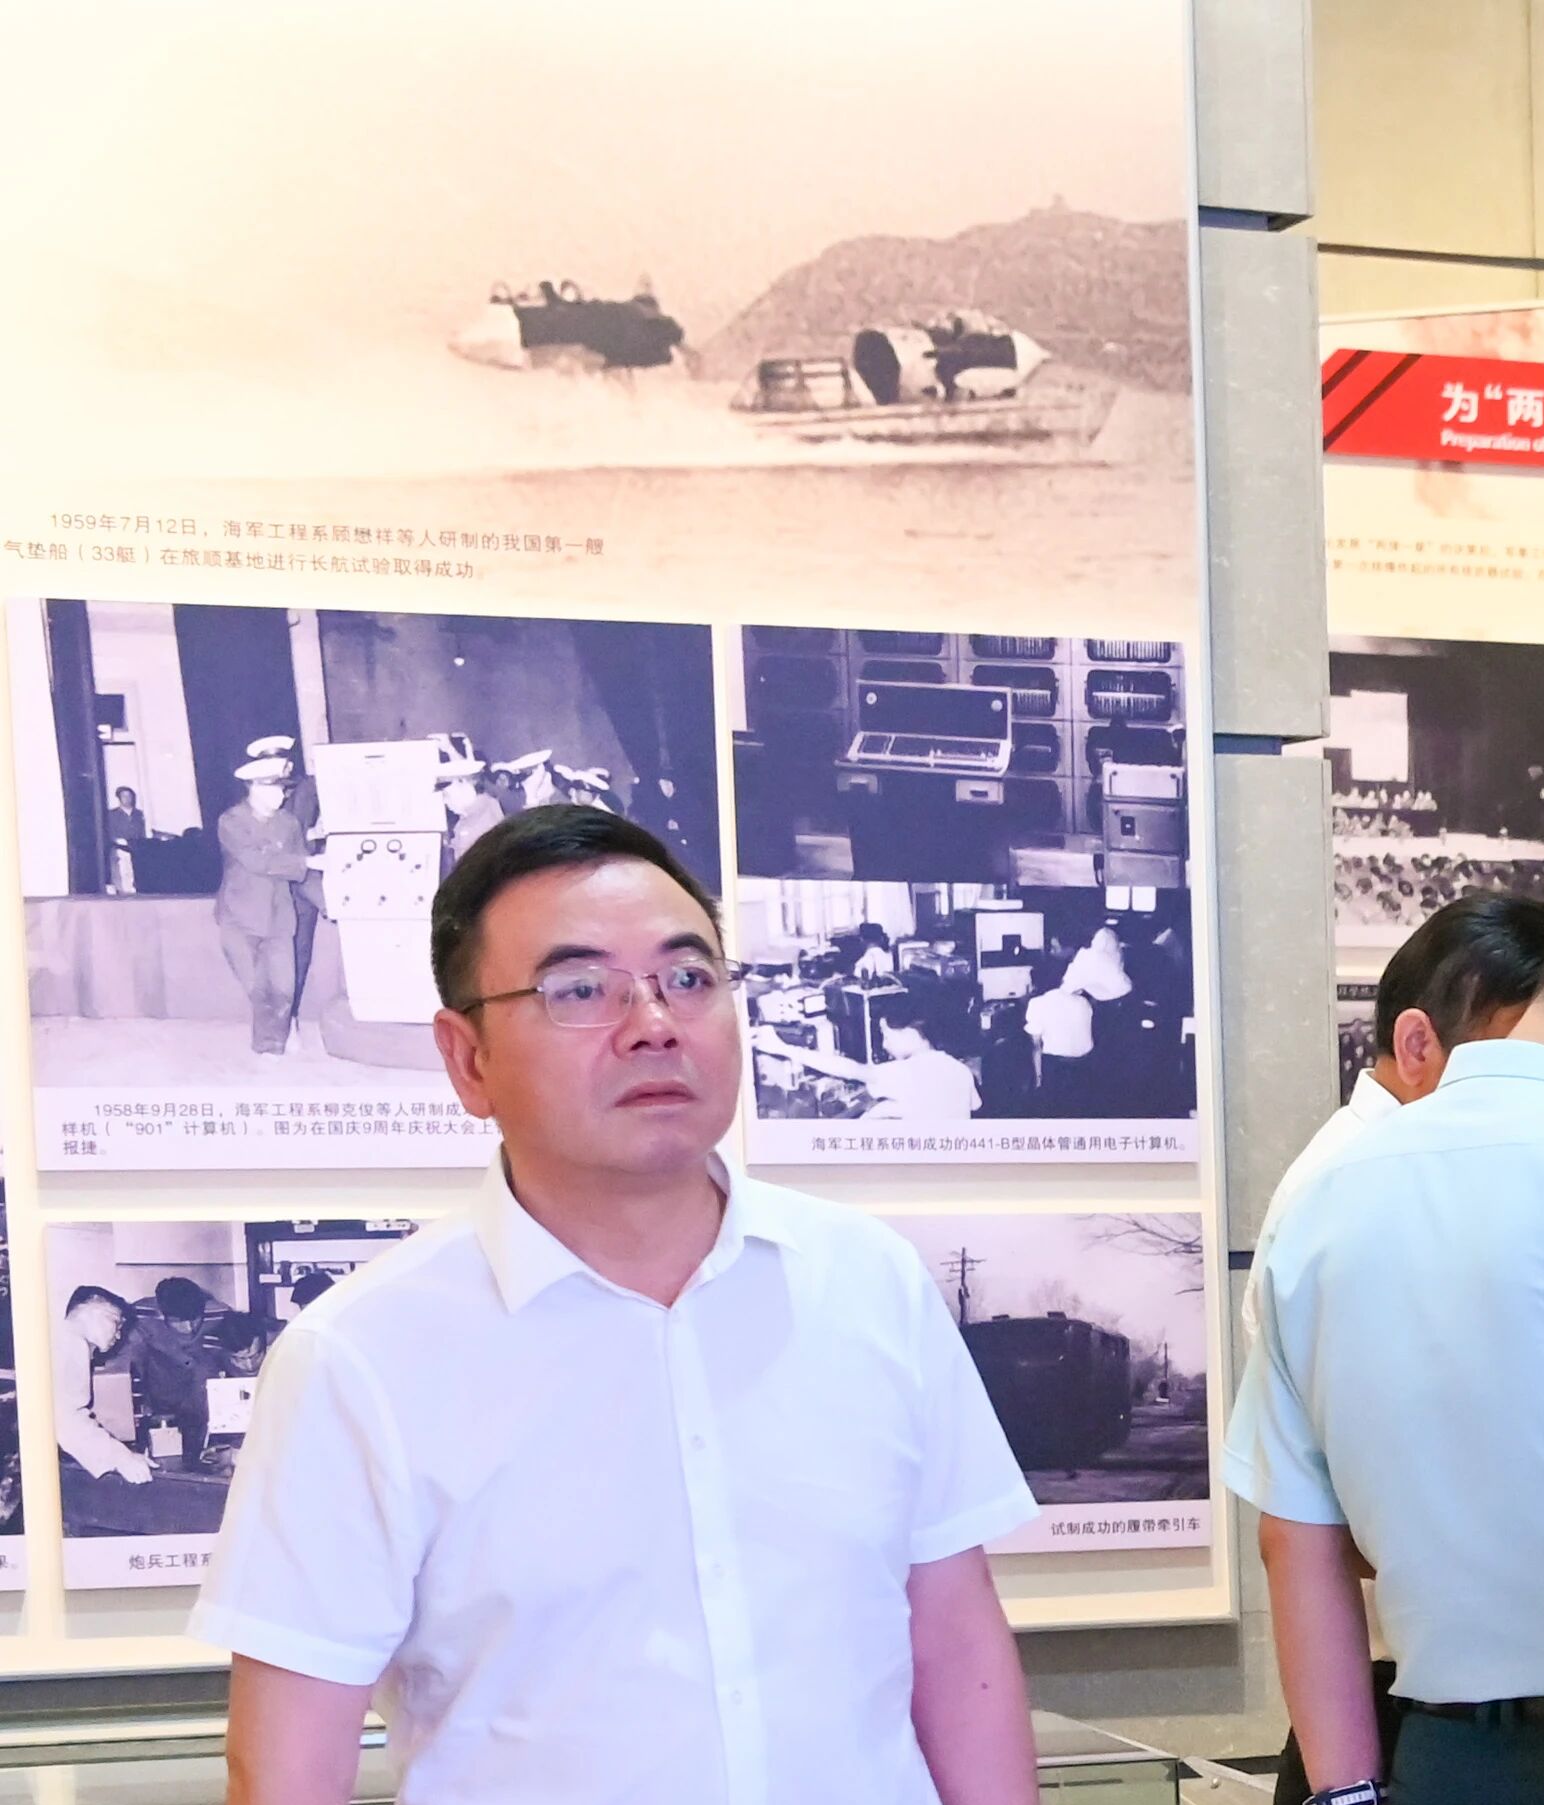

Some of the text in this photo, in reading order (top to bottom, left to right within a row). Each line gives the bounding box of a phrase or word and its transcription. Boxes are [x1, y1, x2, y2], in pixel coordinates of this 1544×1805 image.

[1440, 428, 1531, 452] Preparation
[95, 1103, 466, 1118] 1958年9月28日，海军工程系柳克俊等人研制成
[62, 1120, 502, 1137] 样机（“901”计算机）。图为在国庆9周年庆祝大会上
[63, 1140, 107, 1156] 报捷。
[811, 1136, 1187, 1153] 海军工程系研制成功的441-B型晶体管通用电子计算机。
[1051, 1517, 1201, 1536] 试制成功的履带牵引车
